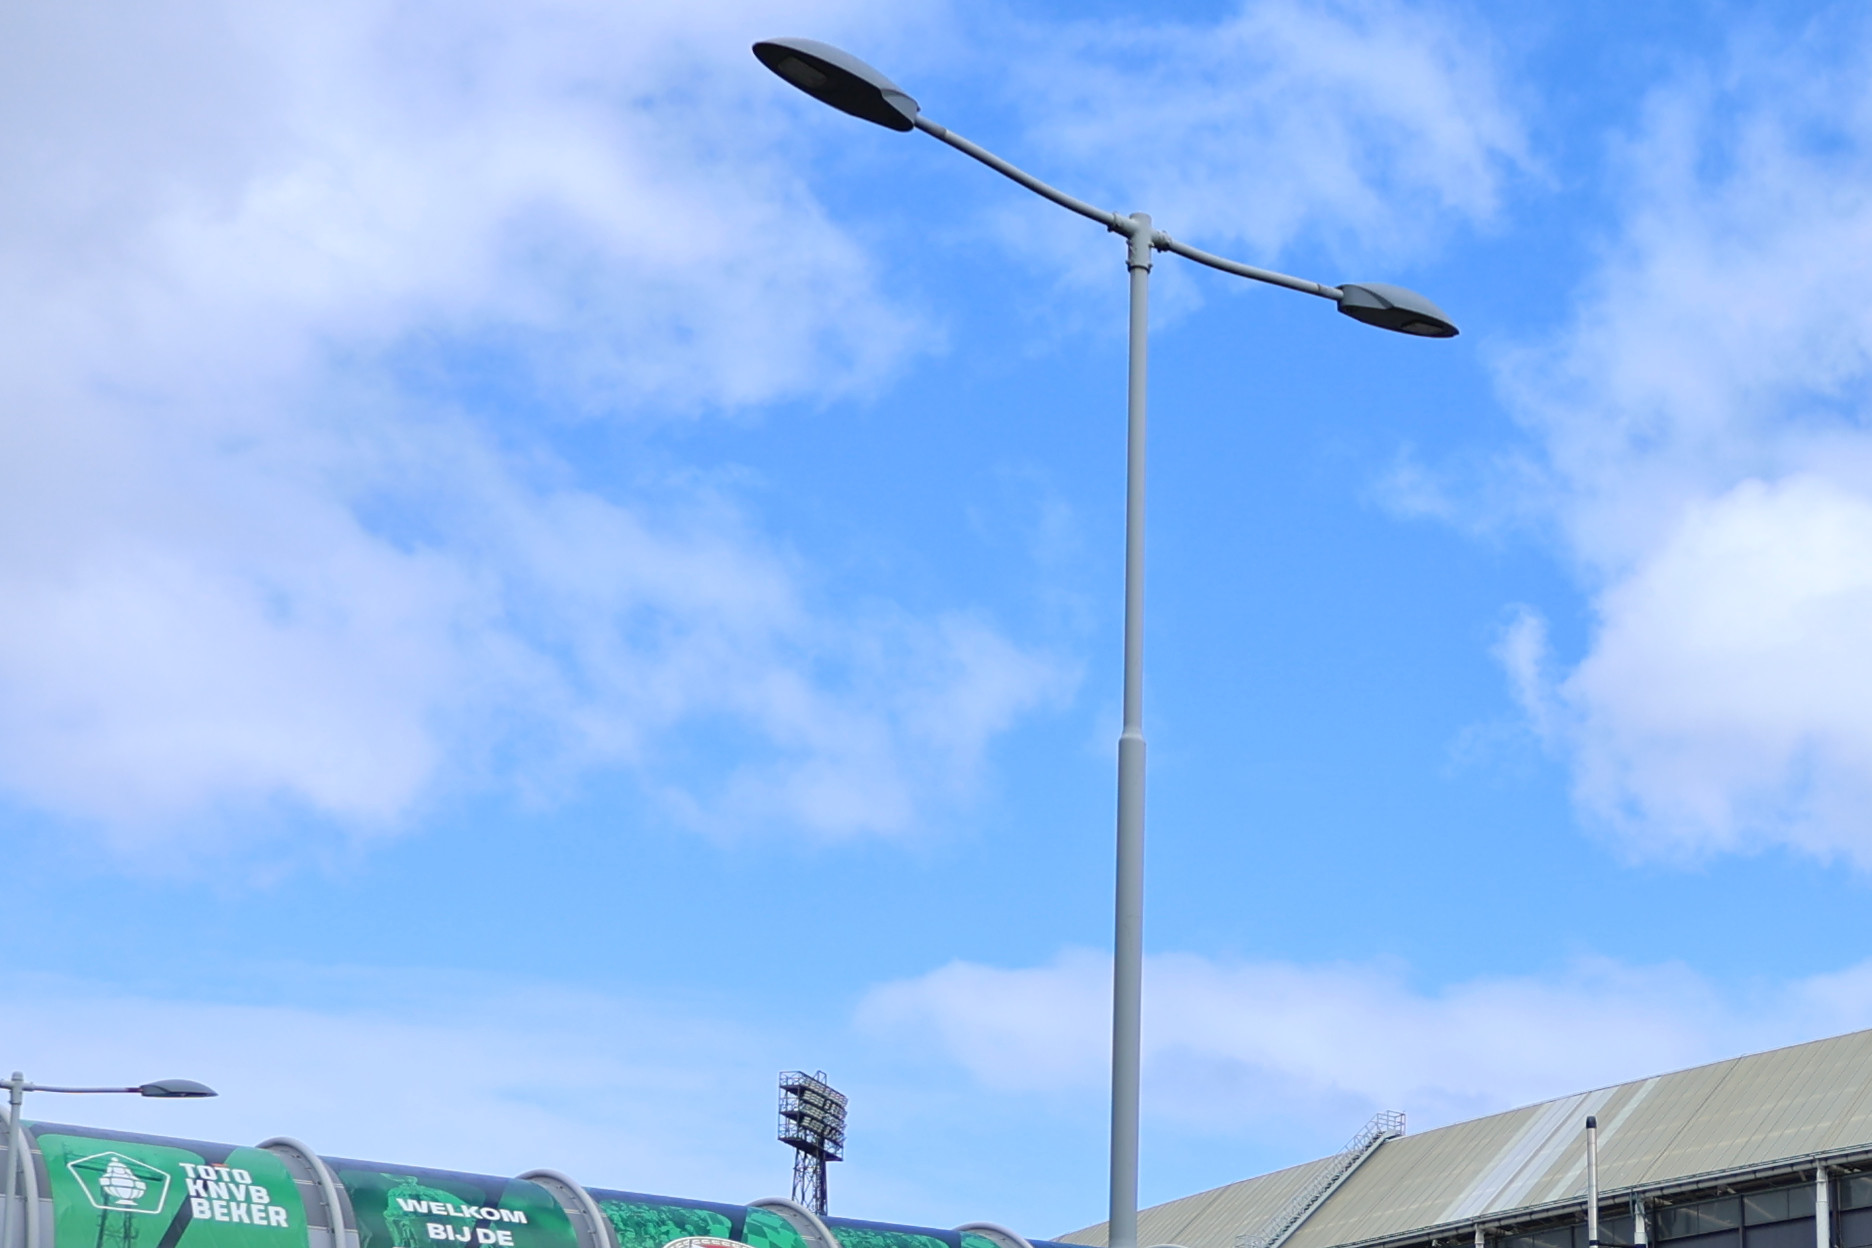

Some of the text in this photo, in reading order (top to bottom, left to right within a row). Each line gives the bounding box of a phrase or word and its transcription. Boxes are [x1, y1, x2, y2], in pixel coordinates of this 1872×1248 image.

[179, 1162, 252, 1184] TOTO
[185, 1178, 270, 1204] KNVB
[190, 1197, 289, 1227] BEKER
[396, 1198, 527, 1223] WELKOM
[427, 1223, 514, 1246] BIJ DE
